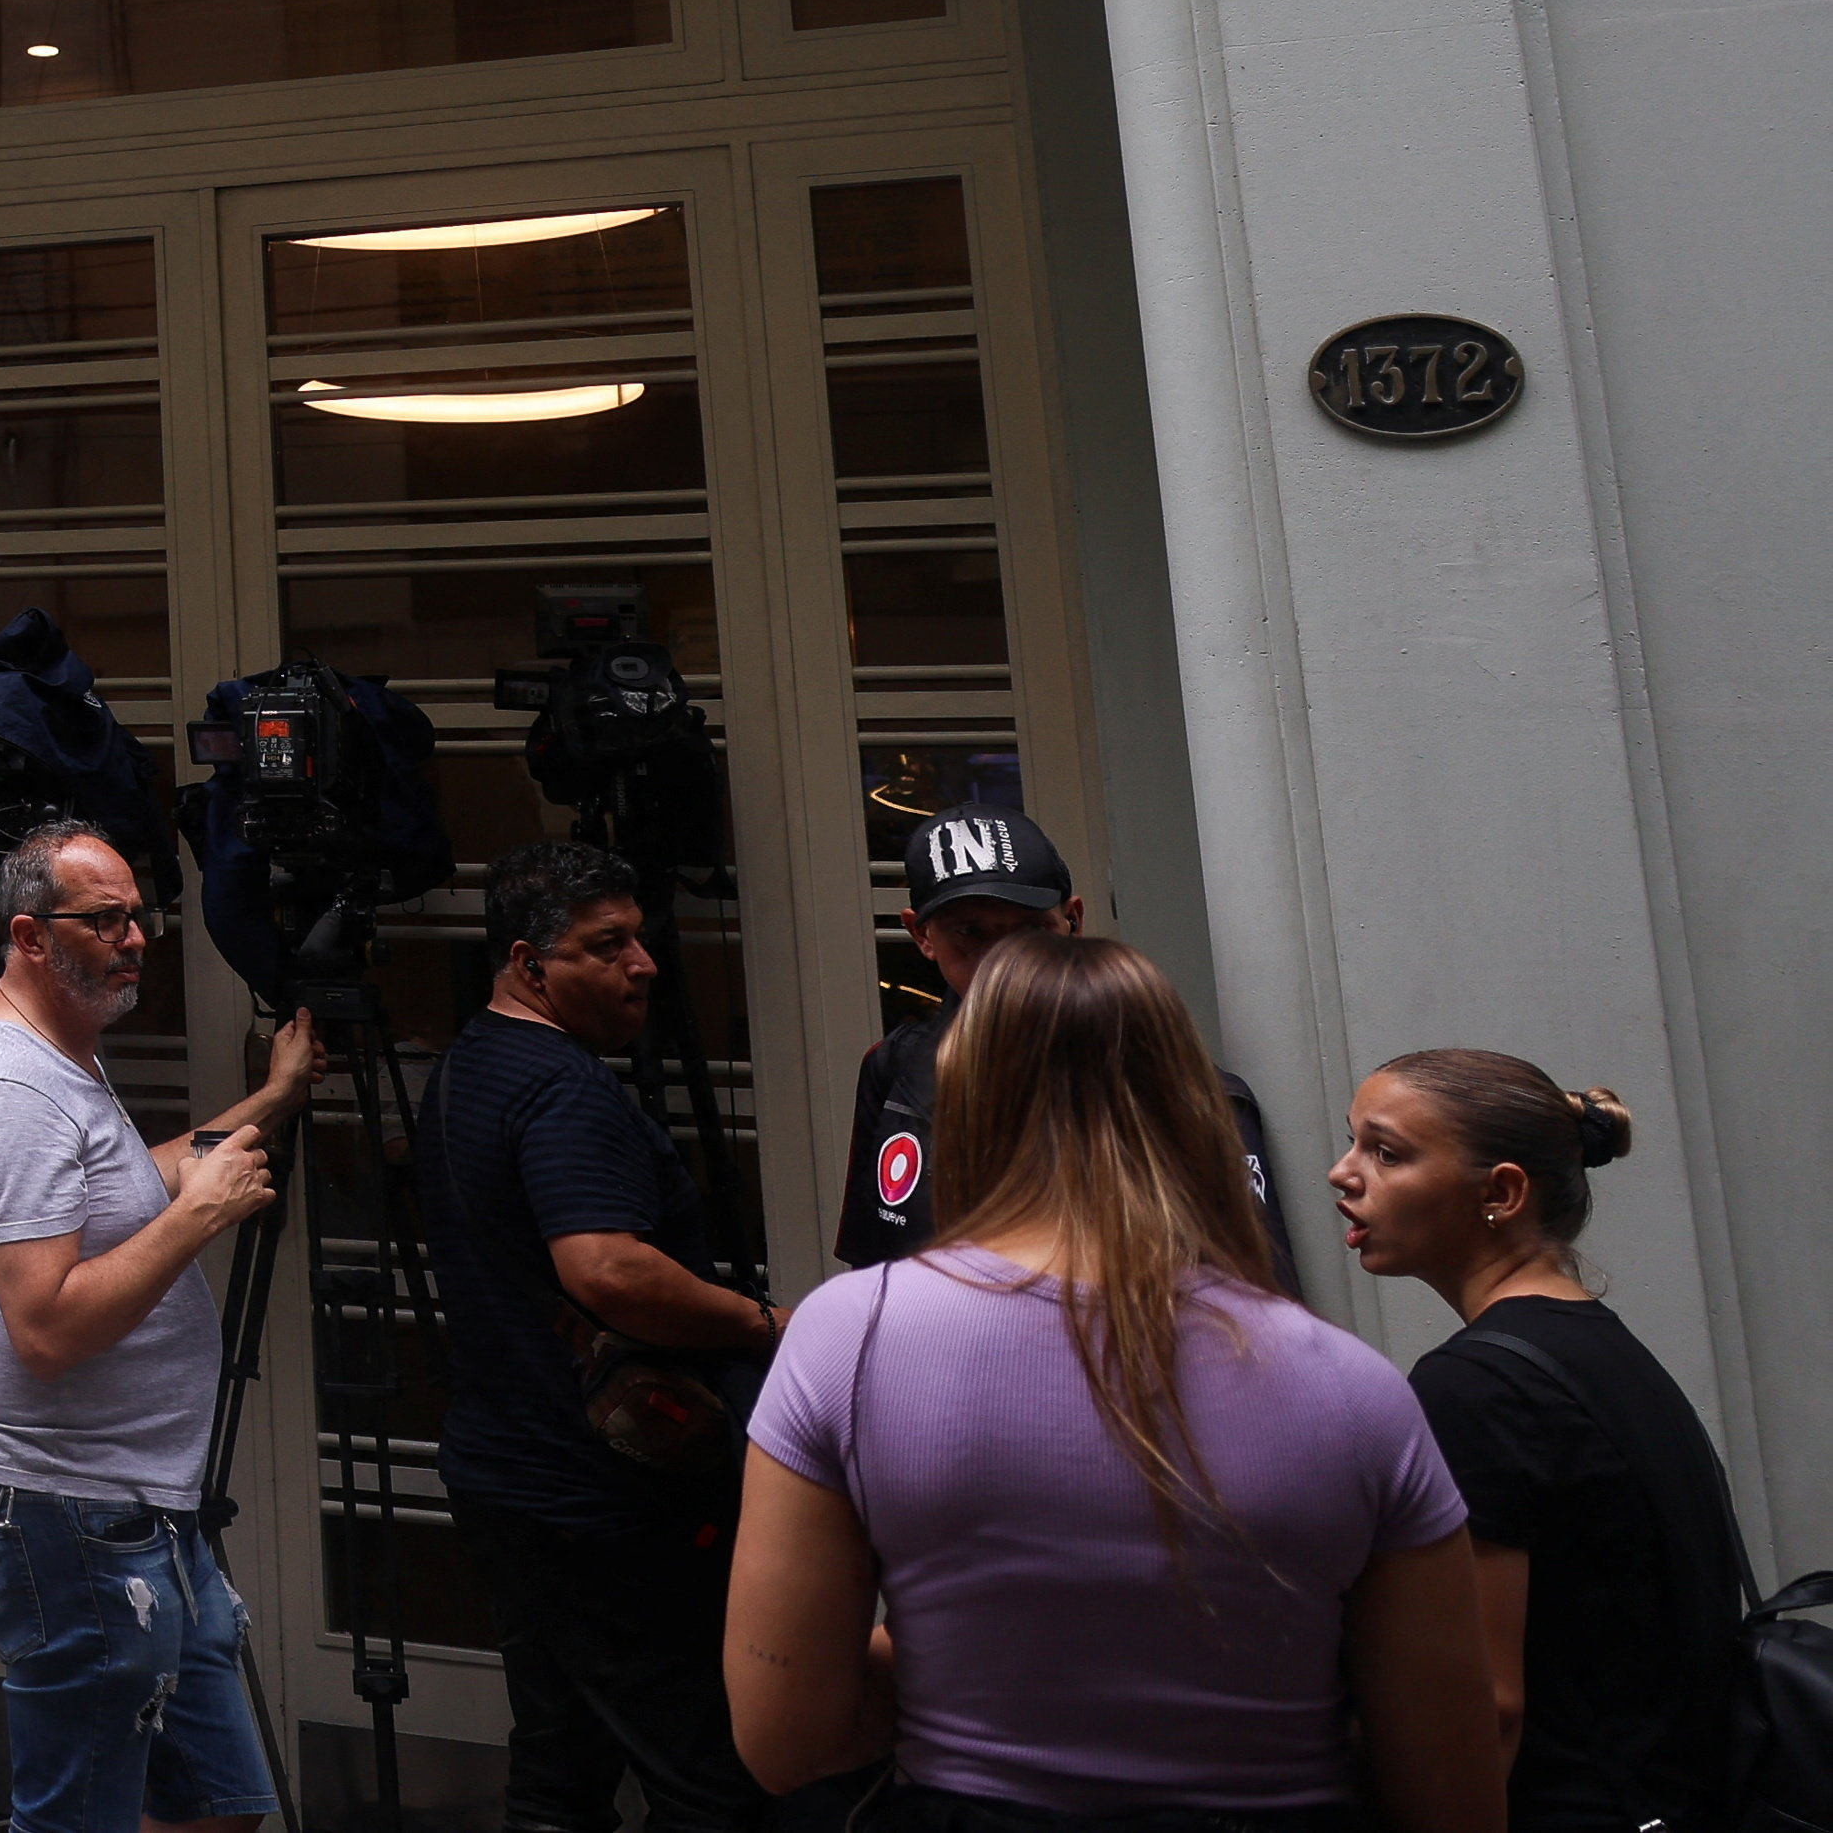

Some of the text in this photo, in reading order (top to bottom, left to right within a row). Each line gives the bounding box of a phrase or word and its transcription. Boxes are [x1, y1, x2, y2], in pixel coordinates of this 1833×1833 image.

[1339, 341, 1494, 408] 1372
[927, 817, 998, 882] IN
[995, 819, 1016, 864] INDICUS
